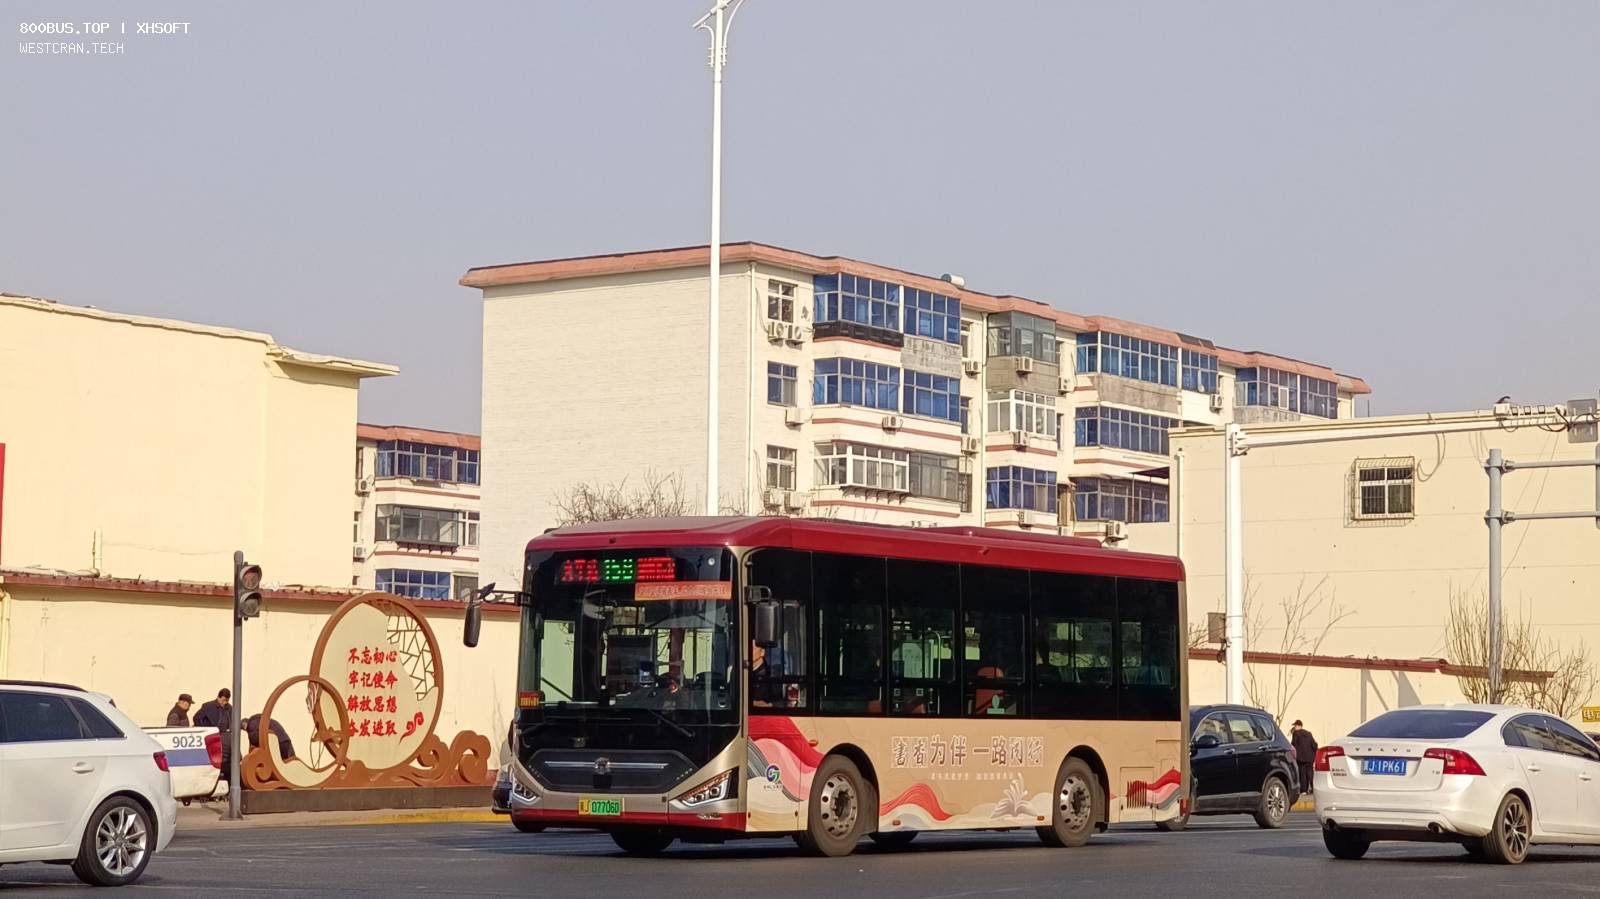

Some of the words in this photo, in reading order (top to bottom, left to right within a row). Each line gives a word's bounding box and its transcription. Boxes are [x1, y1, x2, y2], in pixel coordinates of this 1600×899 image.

[347, 646, 397, 665] 不忘初心
[347, 670, 398, 690] 牢记使命
[347, 694, 397, 713] 解放思想
[172, 735, 203, 748] 9023
